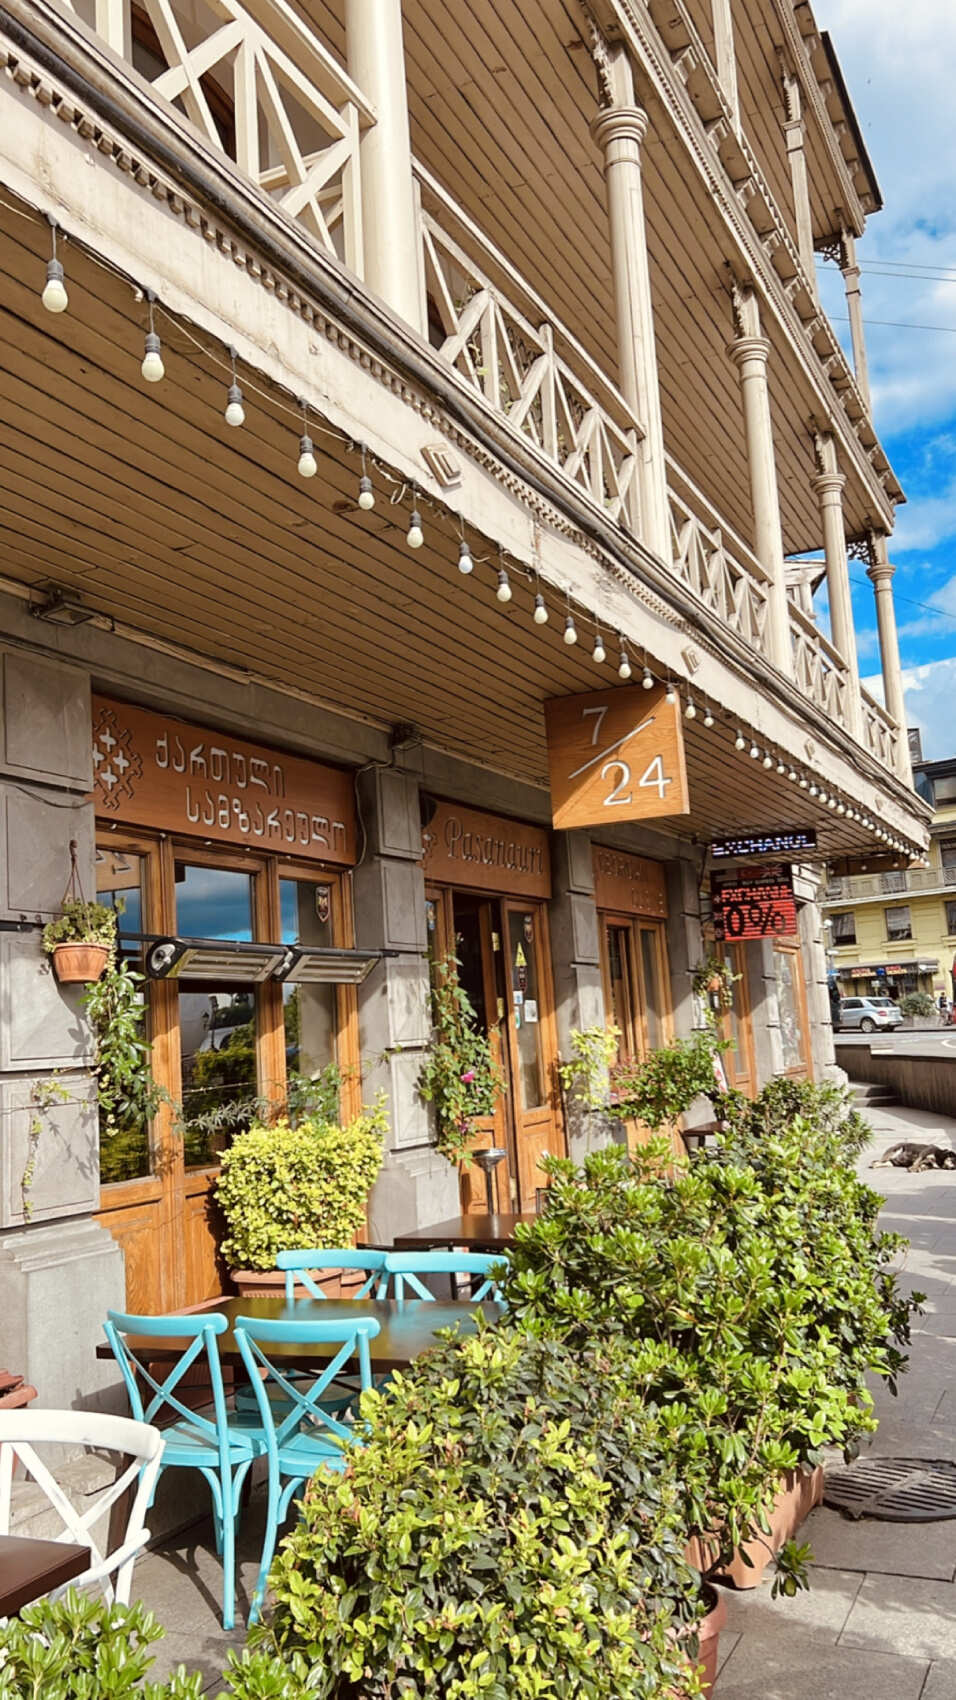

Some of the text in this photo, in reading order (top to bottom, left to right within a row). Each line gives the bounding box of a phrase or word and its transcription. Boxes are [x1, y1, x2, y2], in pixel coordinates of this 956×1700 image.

[582, 705, 609, 745] 7
[155, 731, 286, 799] ქართული
[600, 754, 673, 806] 24
[185, 786, 347, 852] სამზარეულო
[443, 816, 544, 875] Pasanauri
[727, 904, 786, 937] 0%
